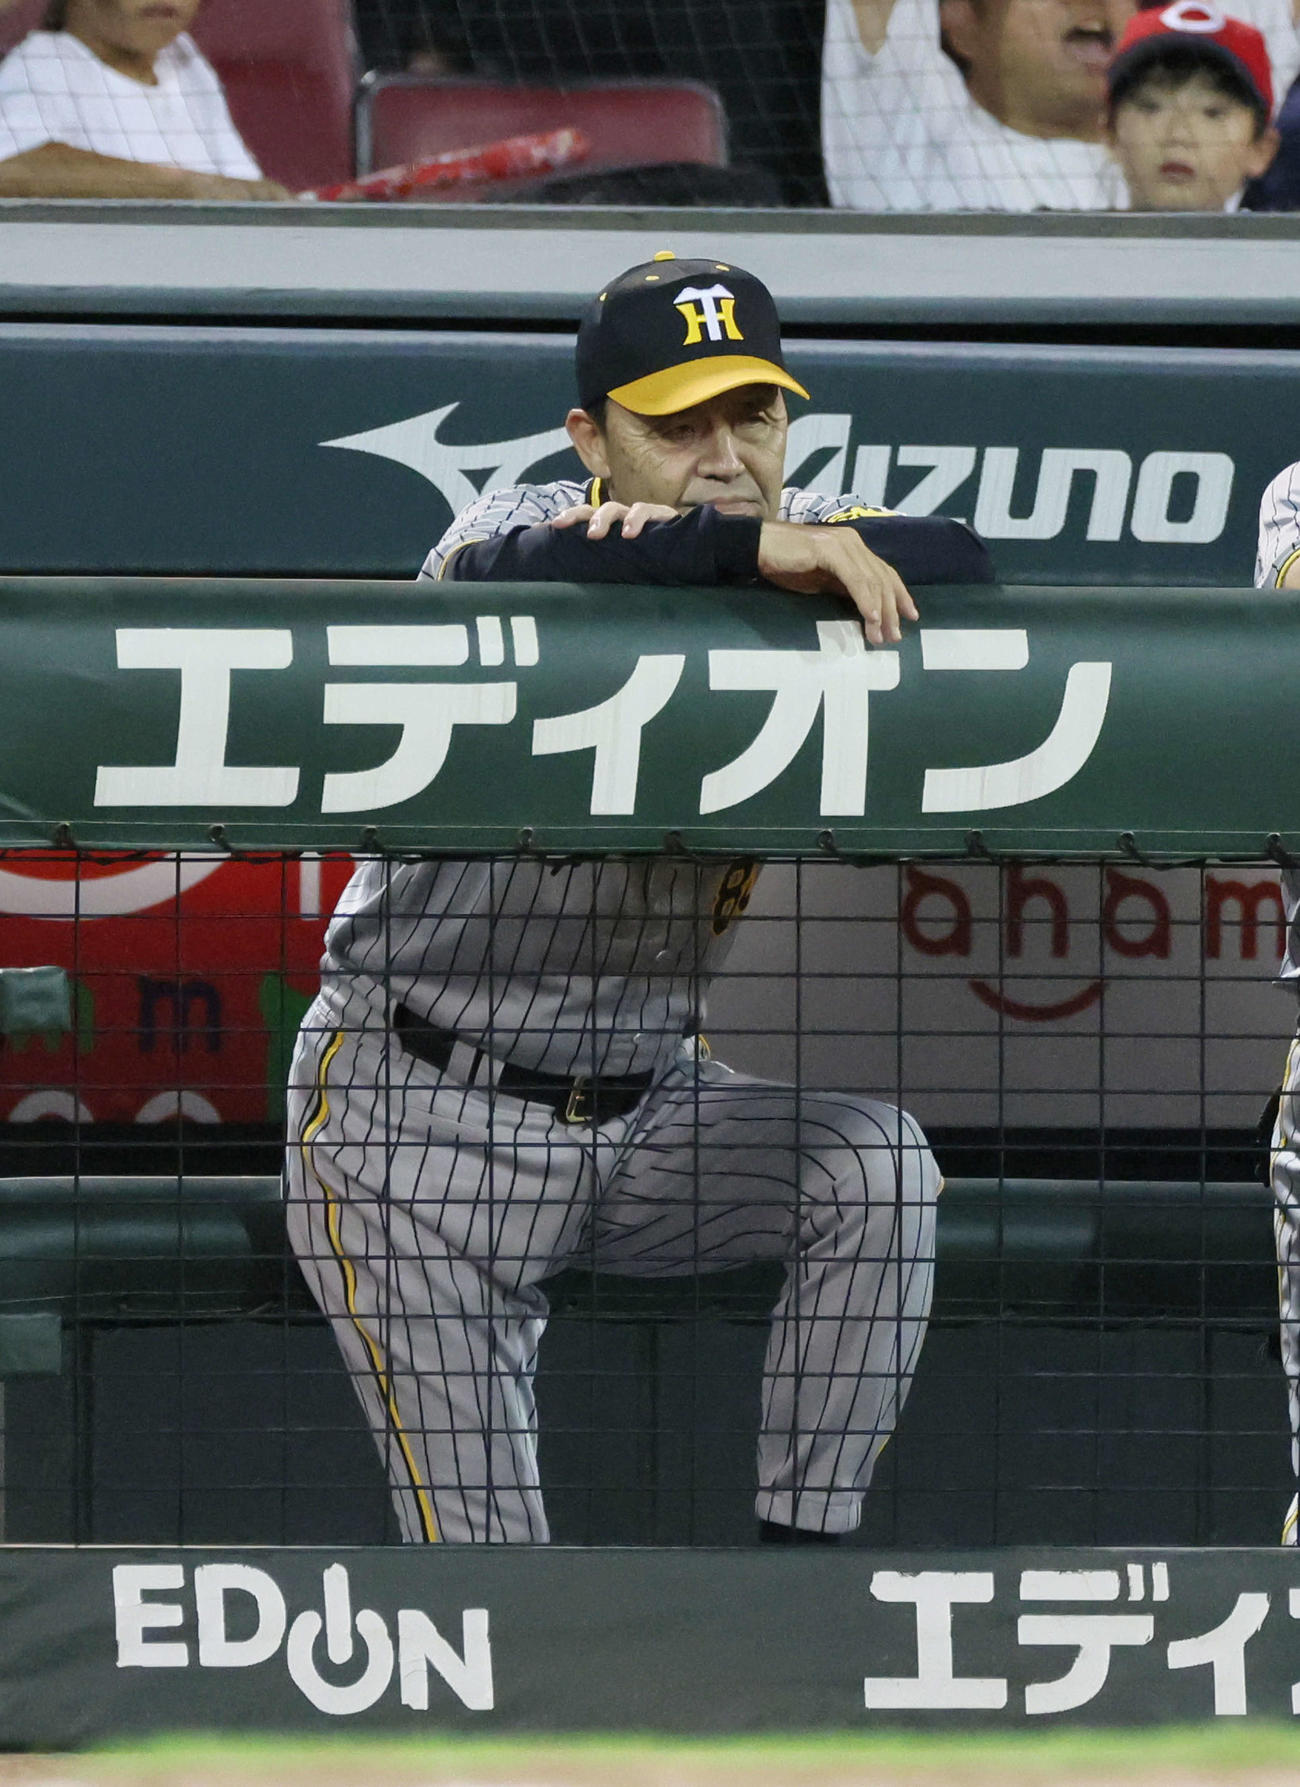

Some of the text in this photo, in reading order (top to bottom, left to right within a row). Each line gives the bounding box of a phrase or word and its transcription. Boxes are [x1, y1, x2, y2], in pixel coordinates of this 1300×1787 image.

[94, 616, 1112, 816] エディオン
[113, 1563, 494, 1715] EDION
[865, 1562, 1300, 1715] エディ
